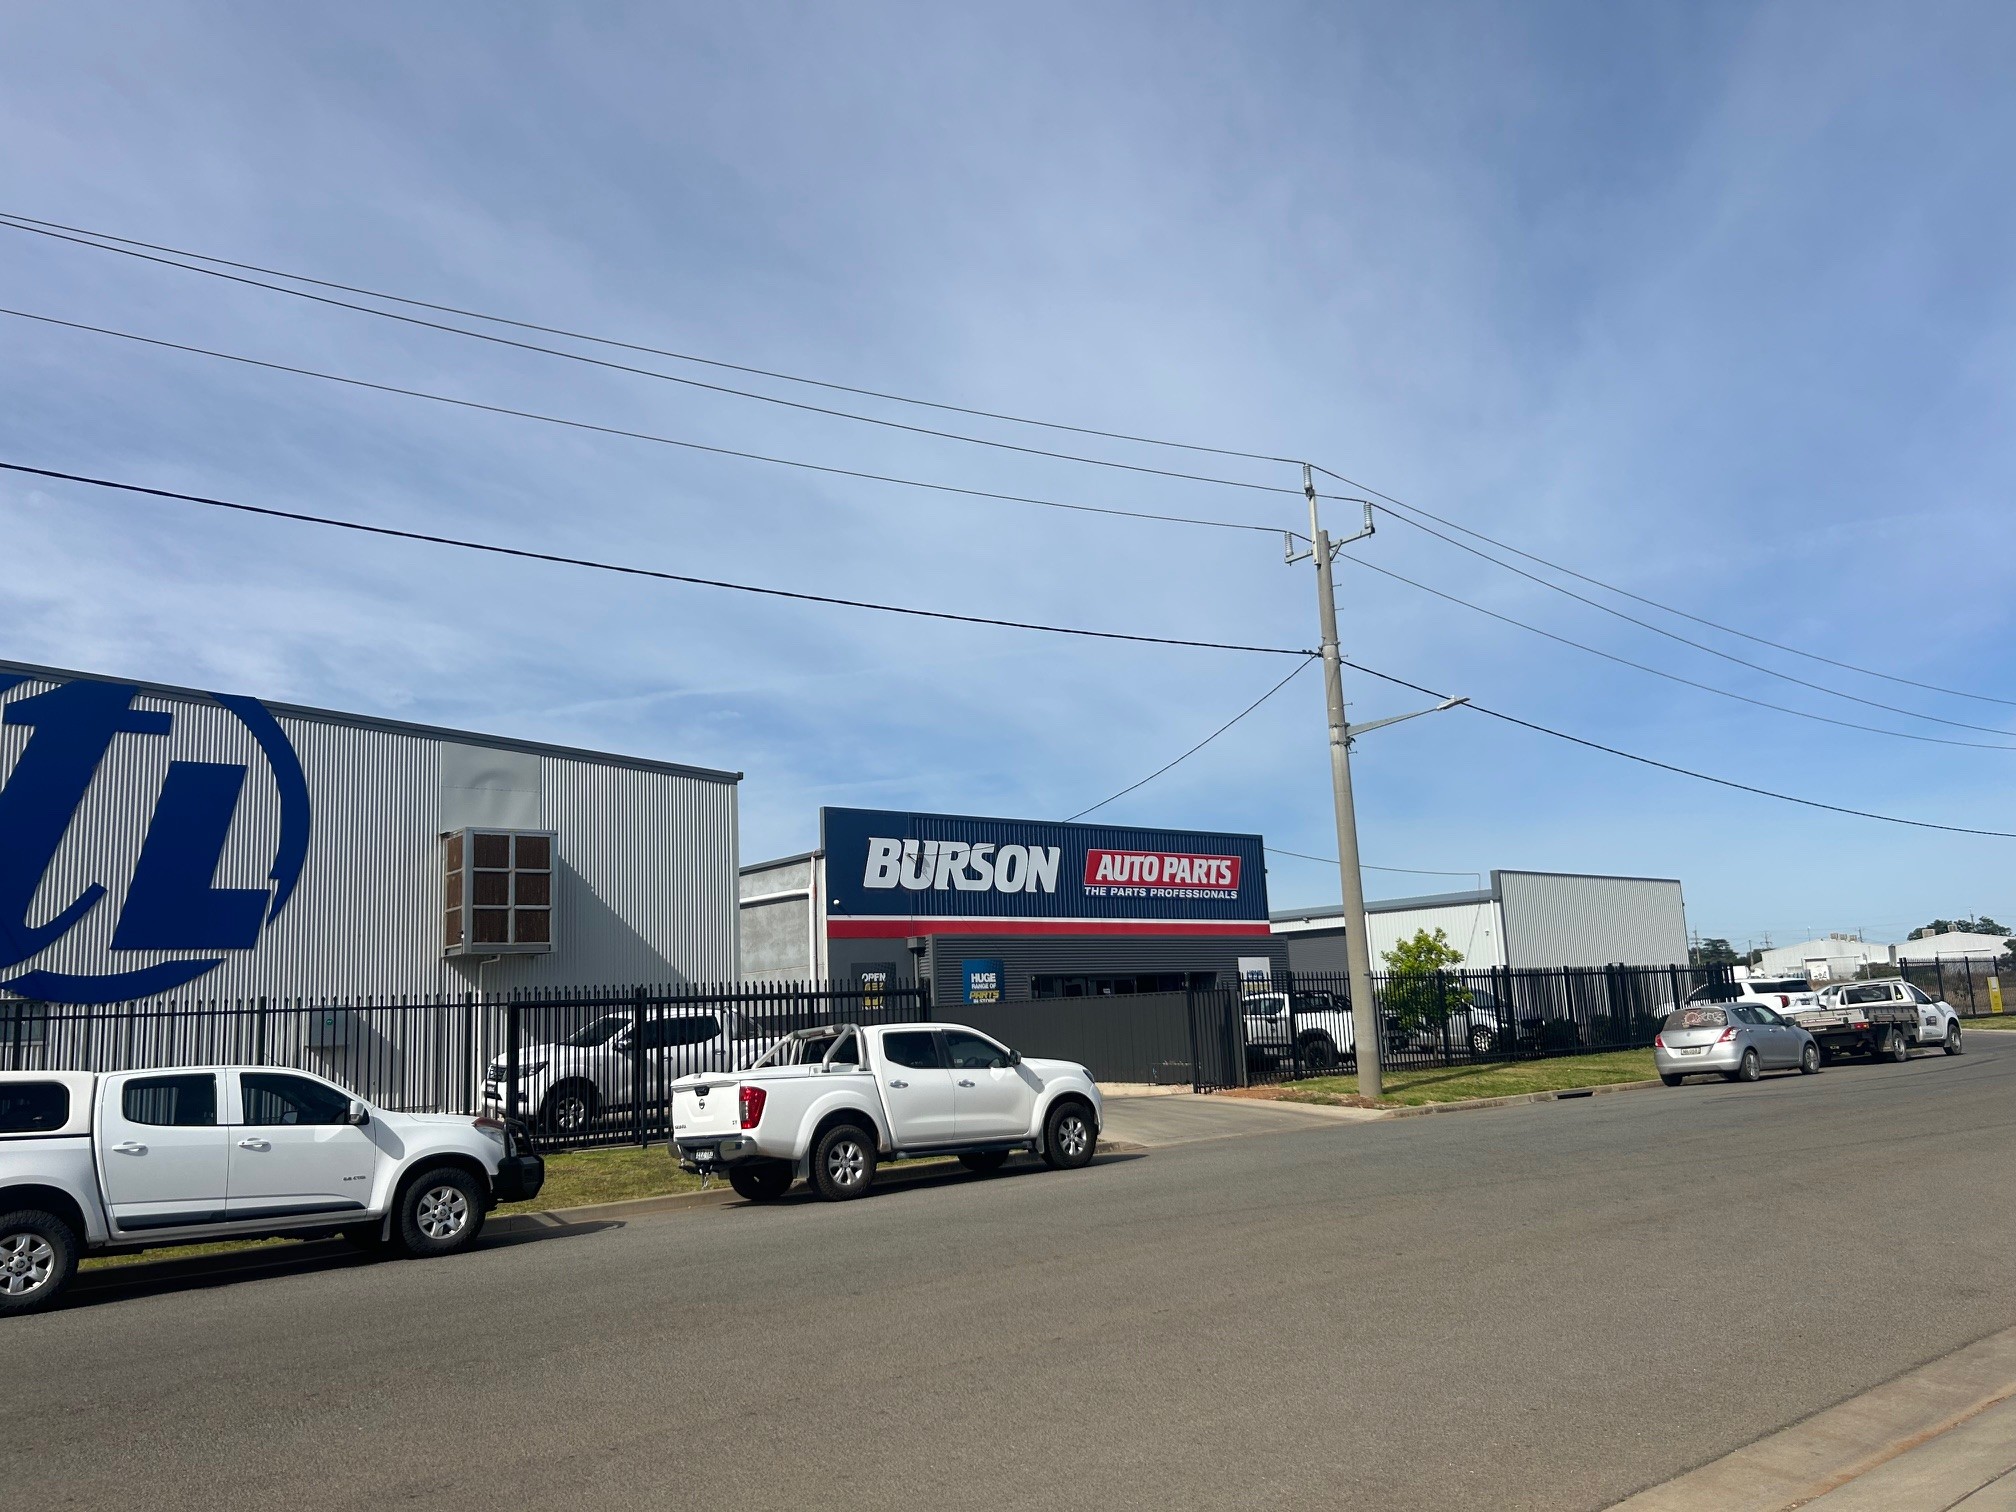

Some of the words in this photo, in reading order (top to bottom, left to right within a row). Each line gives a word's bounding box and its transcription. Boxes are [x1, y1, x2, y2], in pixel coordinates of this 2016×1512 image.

[863, 837, 1061, 893] BURSON
[1095, 854, 1160, 882] AUTO
[1162, 856, 1232, 885] PARTS
[1084, 887, 1107, 896] THE
[1110, 887, 1147, 897] PARTS
[1150, 888, 1238, 899] PROFESSIONALS
[970, 973, 996, 983] HUGE
[969, 990, 1000, 999] PARTS
